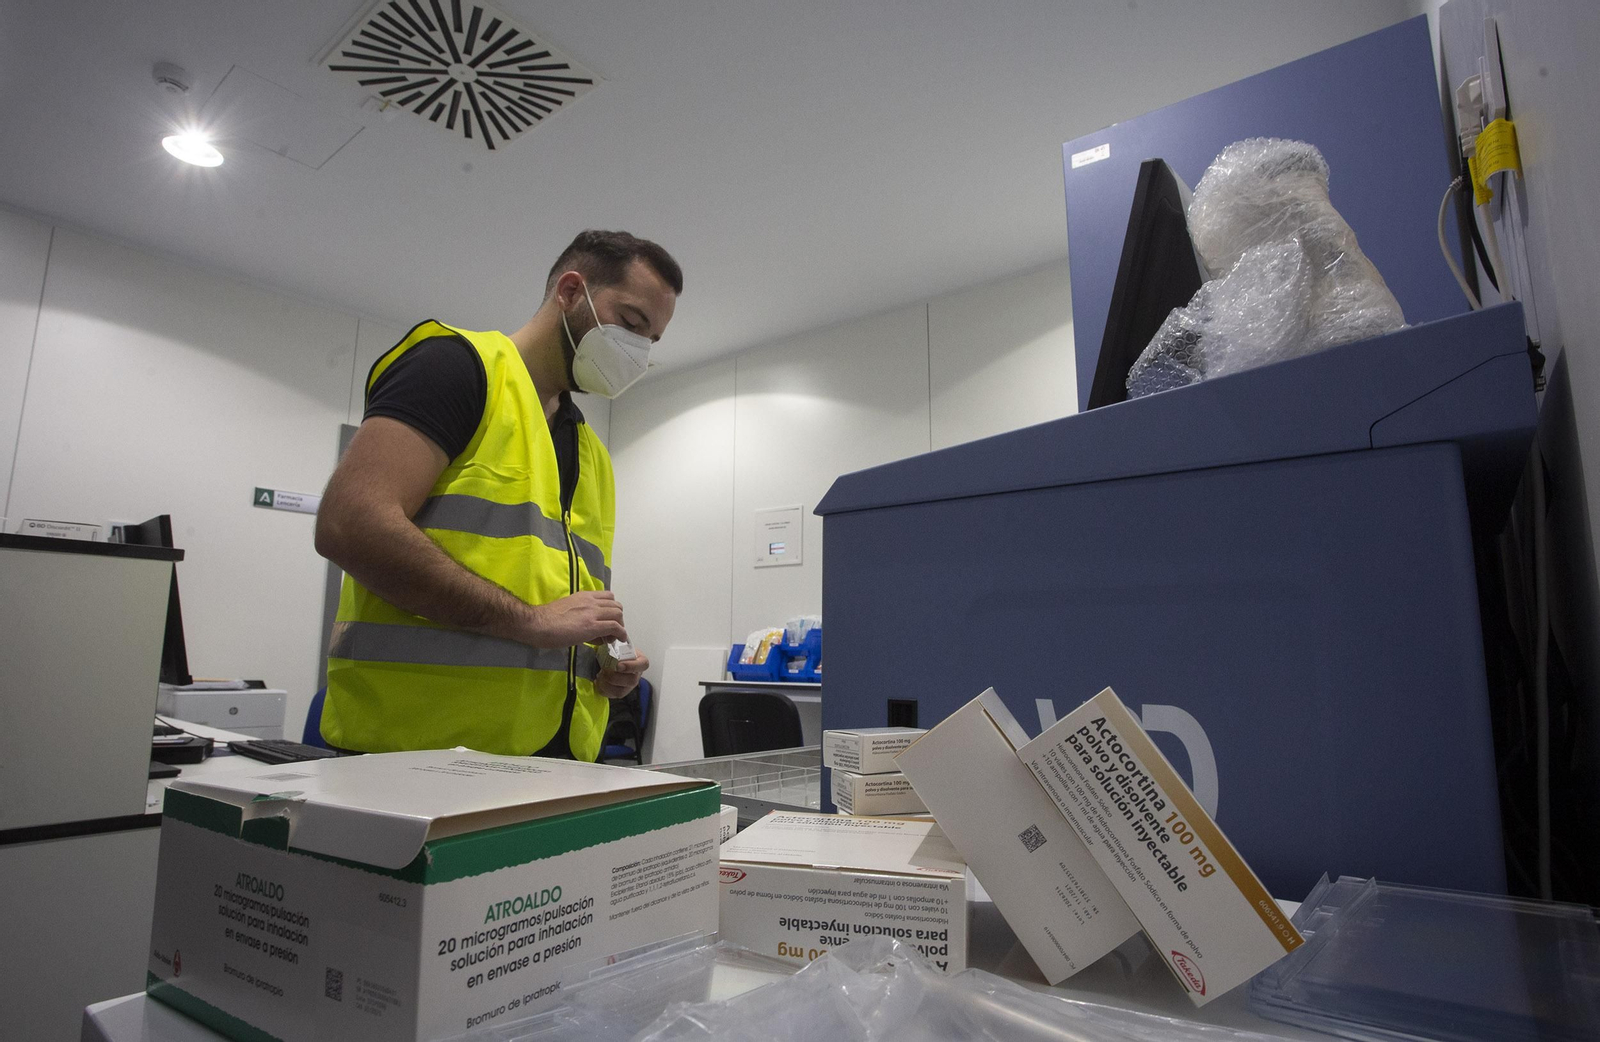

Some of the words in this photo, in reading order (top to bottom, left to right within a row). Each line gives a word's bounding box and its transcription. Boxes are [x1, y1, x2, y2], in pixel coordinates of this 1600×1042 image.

[1056, 743, 1085, 780] Hidrocortisona
[1083, 780, 1099, 799] Fosfato
[1097, 799, 1112, 817] Sódico
[1076, 726, 1110, 763] polvo
[1104, 763, 1119, 772] y
[1115, 774, 1170, 843] disolvente
[1037, 770, 1062, 802] intravenosa
[1064, 807, 1093, 845] intramuscular
[1065, 734, 1092, 765] para
[1090, 765, 1134, 820] solución
[1131, 819, 1187, 892] inyectable
[1091, 717, 1165, 812] Actocortina
[1165, 811, 1194, 845] 100
[1189, 846, 1216, 878] mg
[1043, 755, 1052, 765] +10
[1050, 766, 1070, 791] ampollas
[1069, 791, 1078, 802] con
[1080, 807, 1089, 815] ml
[1093, 825, 1105, 839] agua
[1103, 839, 1115, 853] para
[1114, 853, 1136, 882] inyección
[1049, 749, 1056, 757] 10
[1054, 757, 1067, 773] viales
[1066, 773, 1075, 785] con
[1075, 784, 1085, 796] 100
[1082, 796, 1091, 807] mg
[1089, 806, 1098, 815] de
[1096, 814, 1129, 858] Hidrocortisona
[1128, 857, 1146, 880] Fosfato
[1144, 880, 1161, 902] Sódico
[1160, 902, 1168, 911] en
[1166, 910, 1182, 930] forma
[1180, 931, 1189, 939] de
[1186, 940, 1203, 958] polvo
[214, 884, 222, 898] 20
[236, 873, 284, 902] ATROALDO
[808, 888, 836, 896] inyección
[854, 878, 895, 886] intramuscular
[1065, 884, 1081, 905] 11/2021
[484, 886, 562, 924] ATROALDO
[783, 894, 803, 902] Sódico
[804, 896, 826, 904] Fosfato
[828, 898, 872, 908] Hidrocortisona
[219, 905, 245, 922] solución
[248, 916, 265, 930] para
[267, 923, 308, 945] inhalación
[438, 938, 456, 956] 20
[461, 898, 593, 949] microgramos/pulsación
[779, 917, 849, 936] inyectable
[906, 916, 948, 924] Hidrocortisona
[1073, 909, 1085, 925] Lote:
[1259, 900, 1284, 929] 606541.9
[225, 928, 233, 937] en
[236, 932, 260, 949] envase
[263, 942, 268, 952] a
[270, 945, 298, 964] presión
[450, 944, 504, 971] solución
[508, 933, 535, 955] para
[539, 914, 593, 941] inhalación
[853, 924, 912, 938] solución
[916, 929, 947, 941] para
[467, 974, 483, 988] en
[487, 956, 529, 980] envase
[533, 952, 540, 963] a
[543, 937, 581, 962] presión
[778, 942, 803, 958] mg
[224, 963, 245, 980] Bromuro
[247, 975, 254, 984] de
[255, 979, 283, 997] ipratropio
[1177, 958, 1201, 989] Takeda
[466, 1005, 506, 1029] Bromuro
[507, 995, 521, 1012] de
